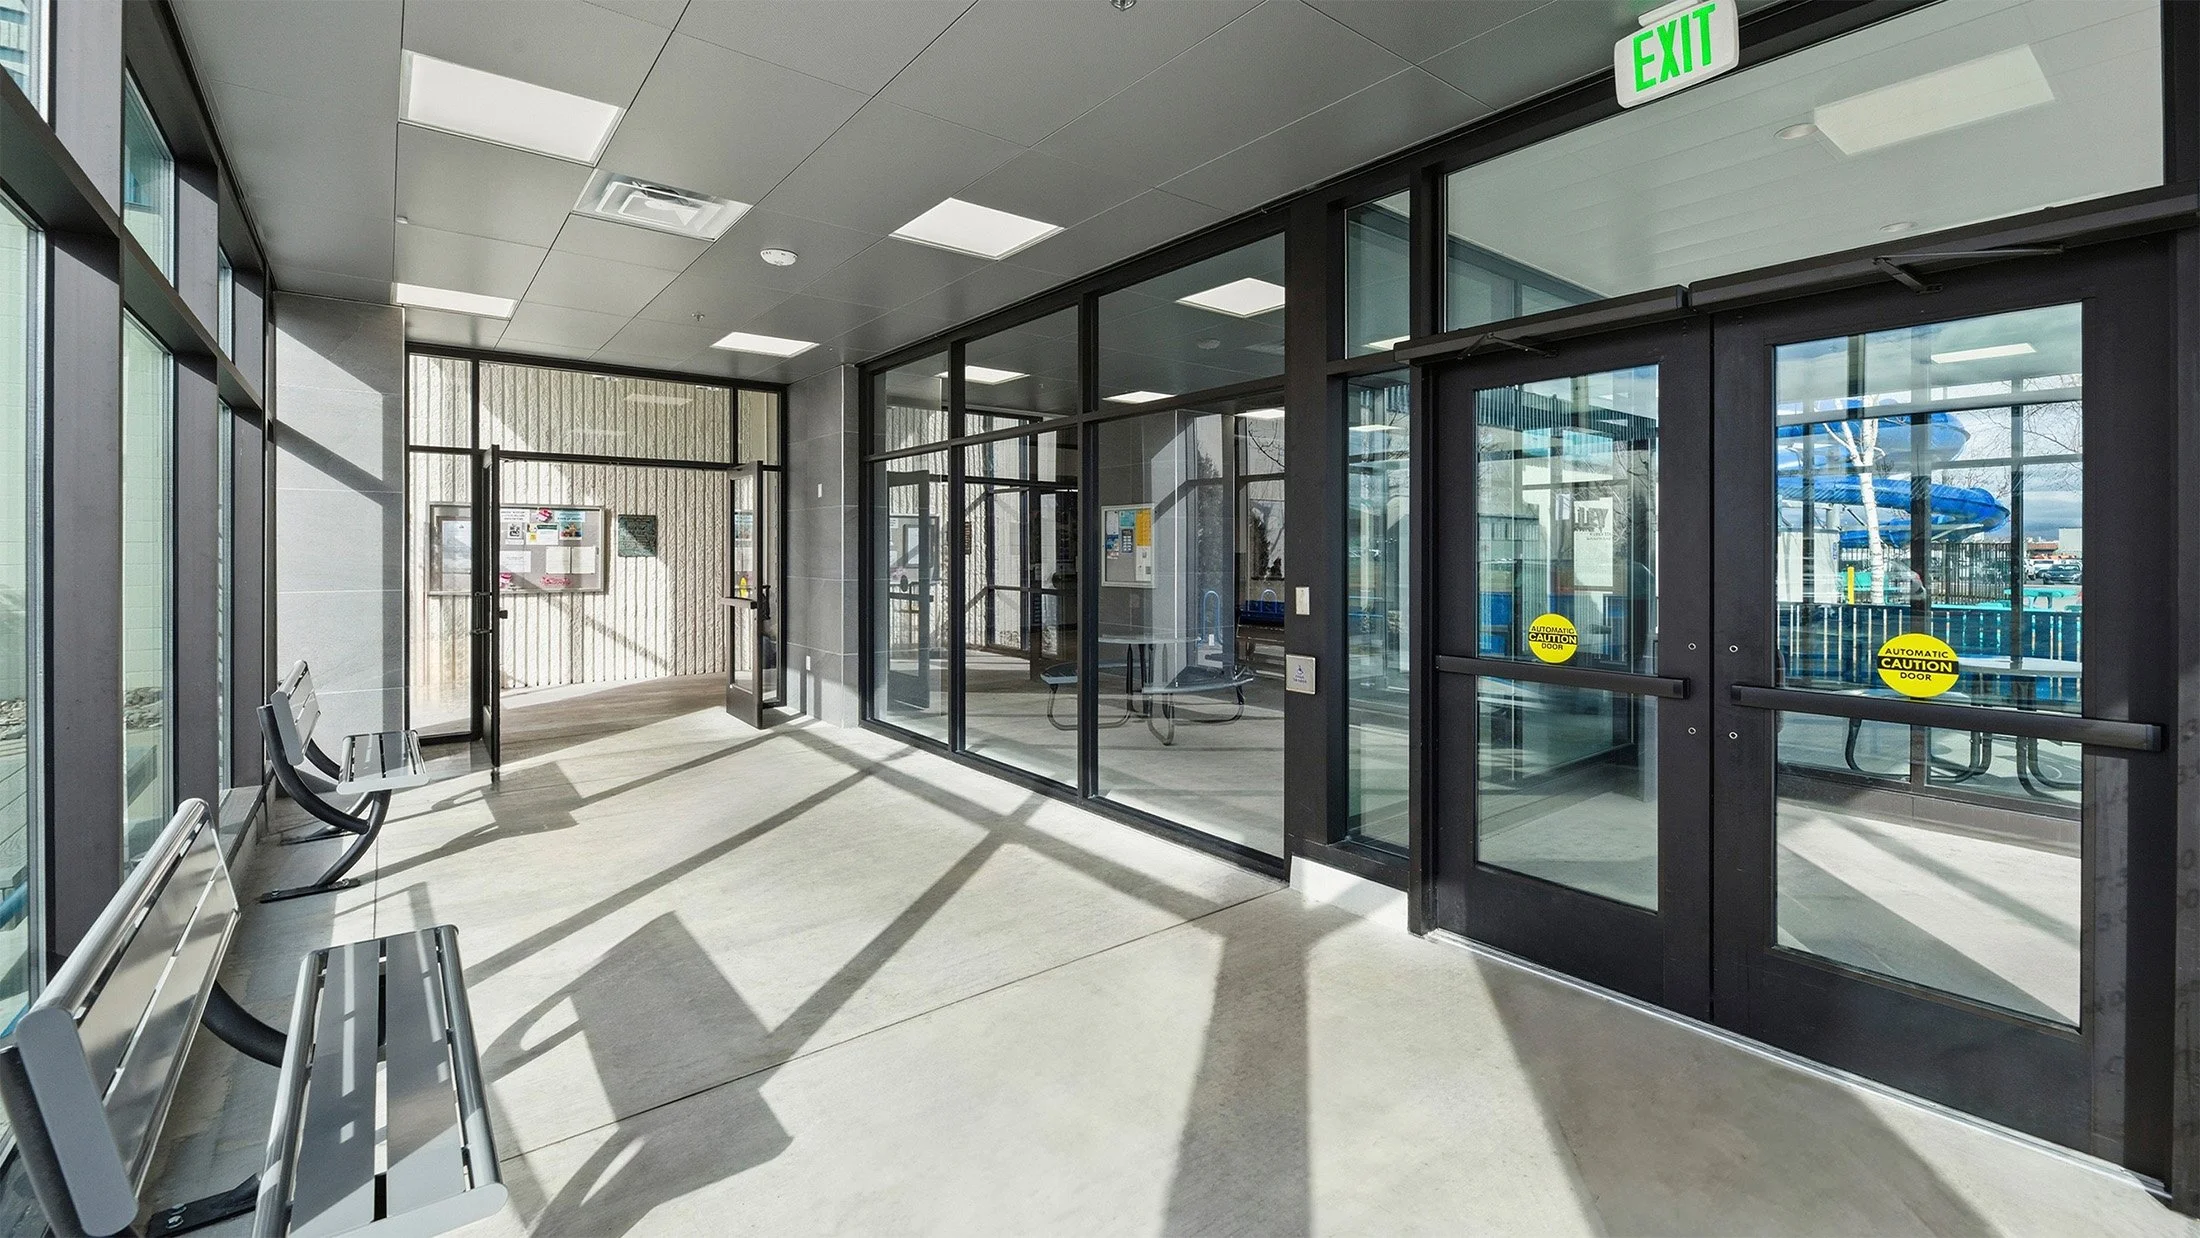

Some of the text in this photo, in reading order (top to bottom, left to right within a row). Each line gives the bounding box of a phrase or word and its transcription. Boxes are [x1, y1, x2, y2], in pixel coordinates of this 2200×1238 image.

[1633, 3, 1716, 92] EXIT
[1531, 625, 1575, 635] AUTOMATIC
[1529, 633, 1577, 644] CAUTION
[1885, 648, 1948, 658] AUTOMATIC
[1881, 658, 1952, 673] CAUTION
[1900, 672, 1931, 681] DOOR
